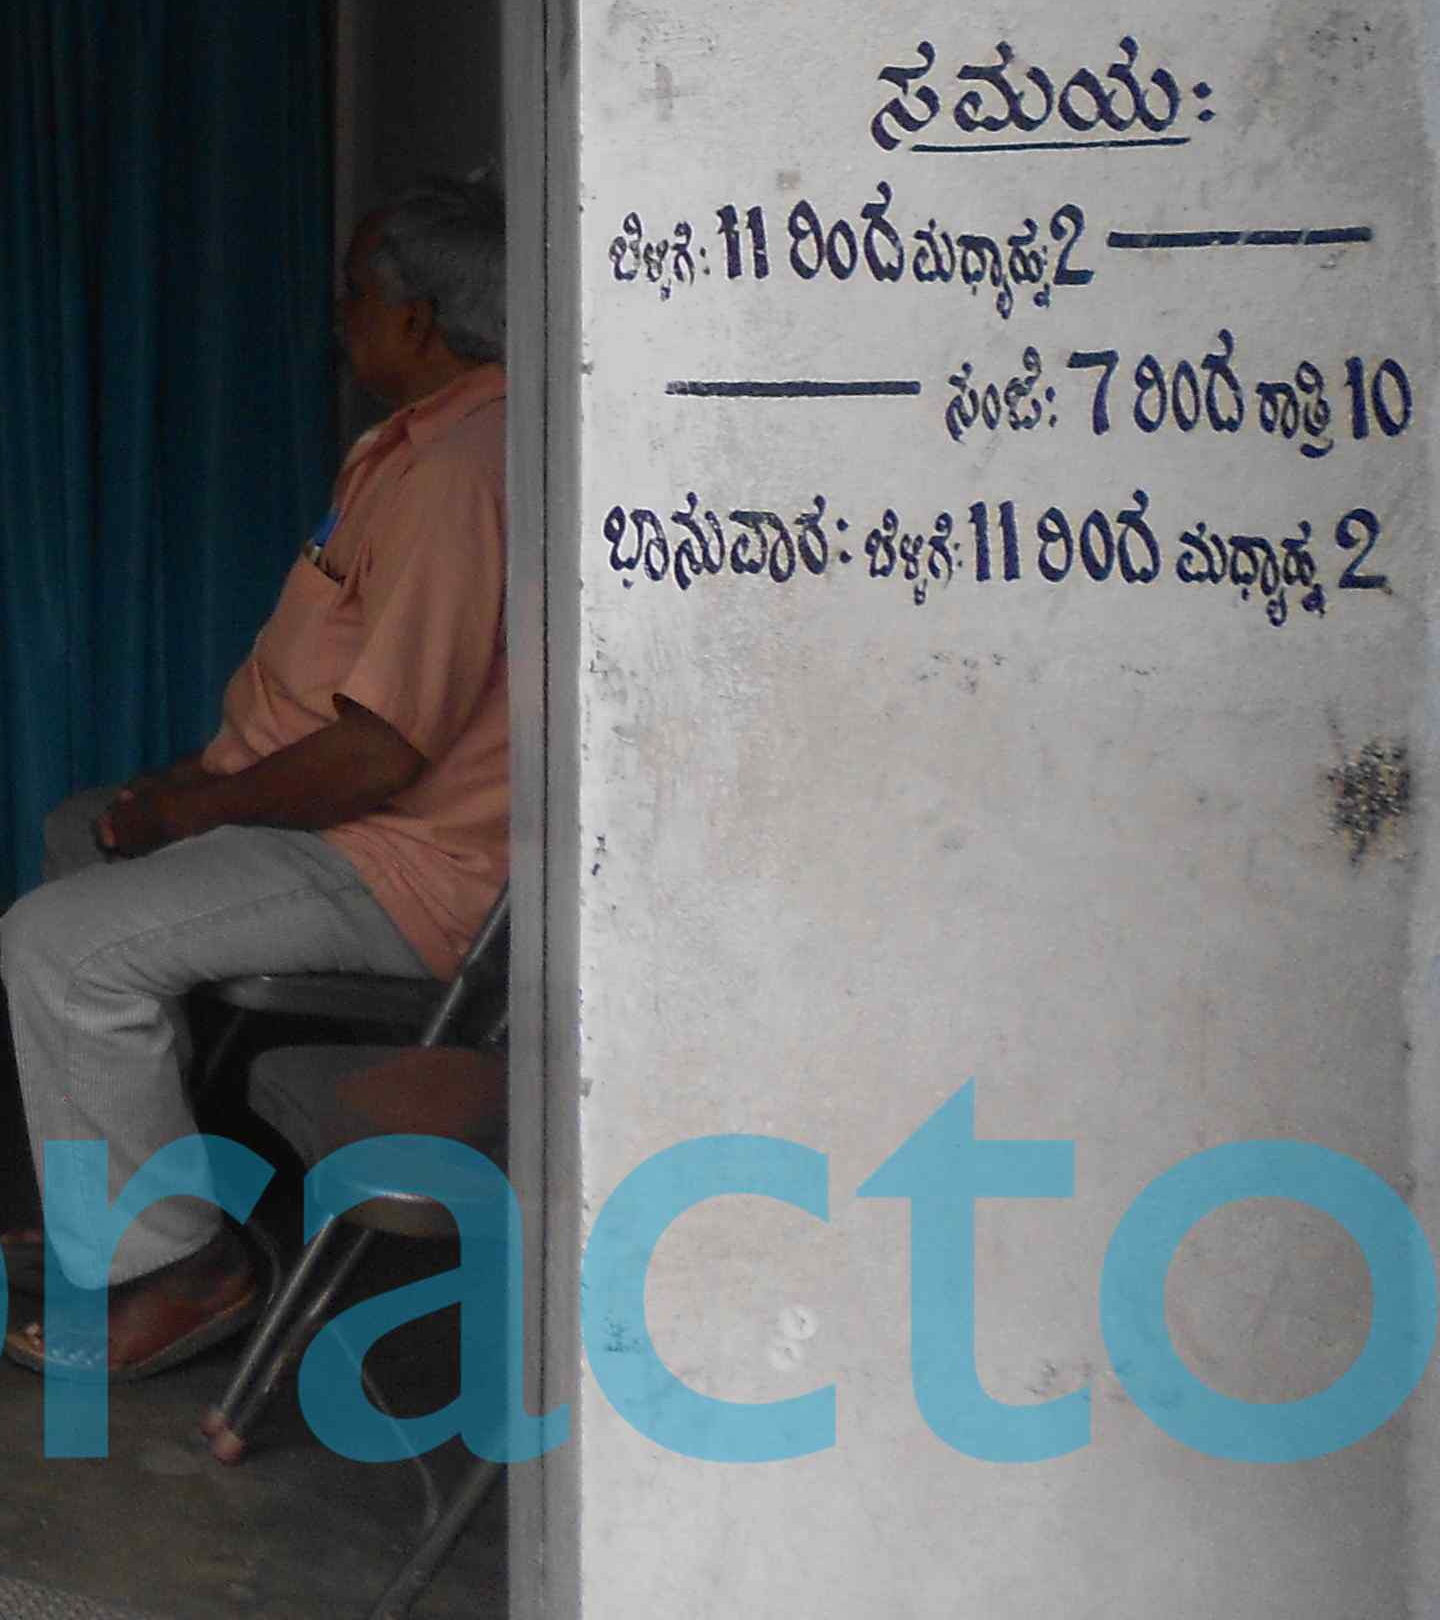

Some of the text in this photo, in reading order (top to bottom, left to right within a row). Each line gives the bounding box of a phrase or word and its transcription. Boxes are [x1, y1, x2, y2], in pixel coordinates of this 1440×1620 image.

[870, 35, 1216, 153] ಸಮಯ:
[715, 204, 769, 280] 11
[787, 181, 905, 283] ರಿಂದ
[1066, 350, 1119, 436] 7
[1133, 328, 1245, 433] ರಿಂದ
[1344, 356, 1412, 440] 10
[603, 491, 853, 591] ಭಾನುವಾರ:
[968, 500, 1021, 583] 11
[1037, 489, 1161, 584] ರಿಂದ
